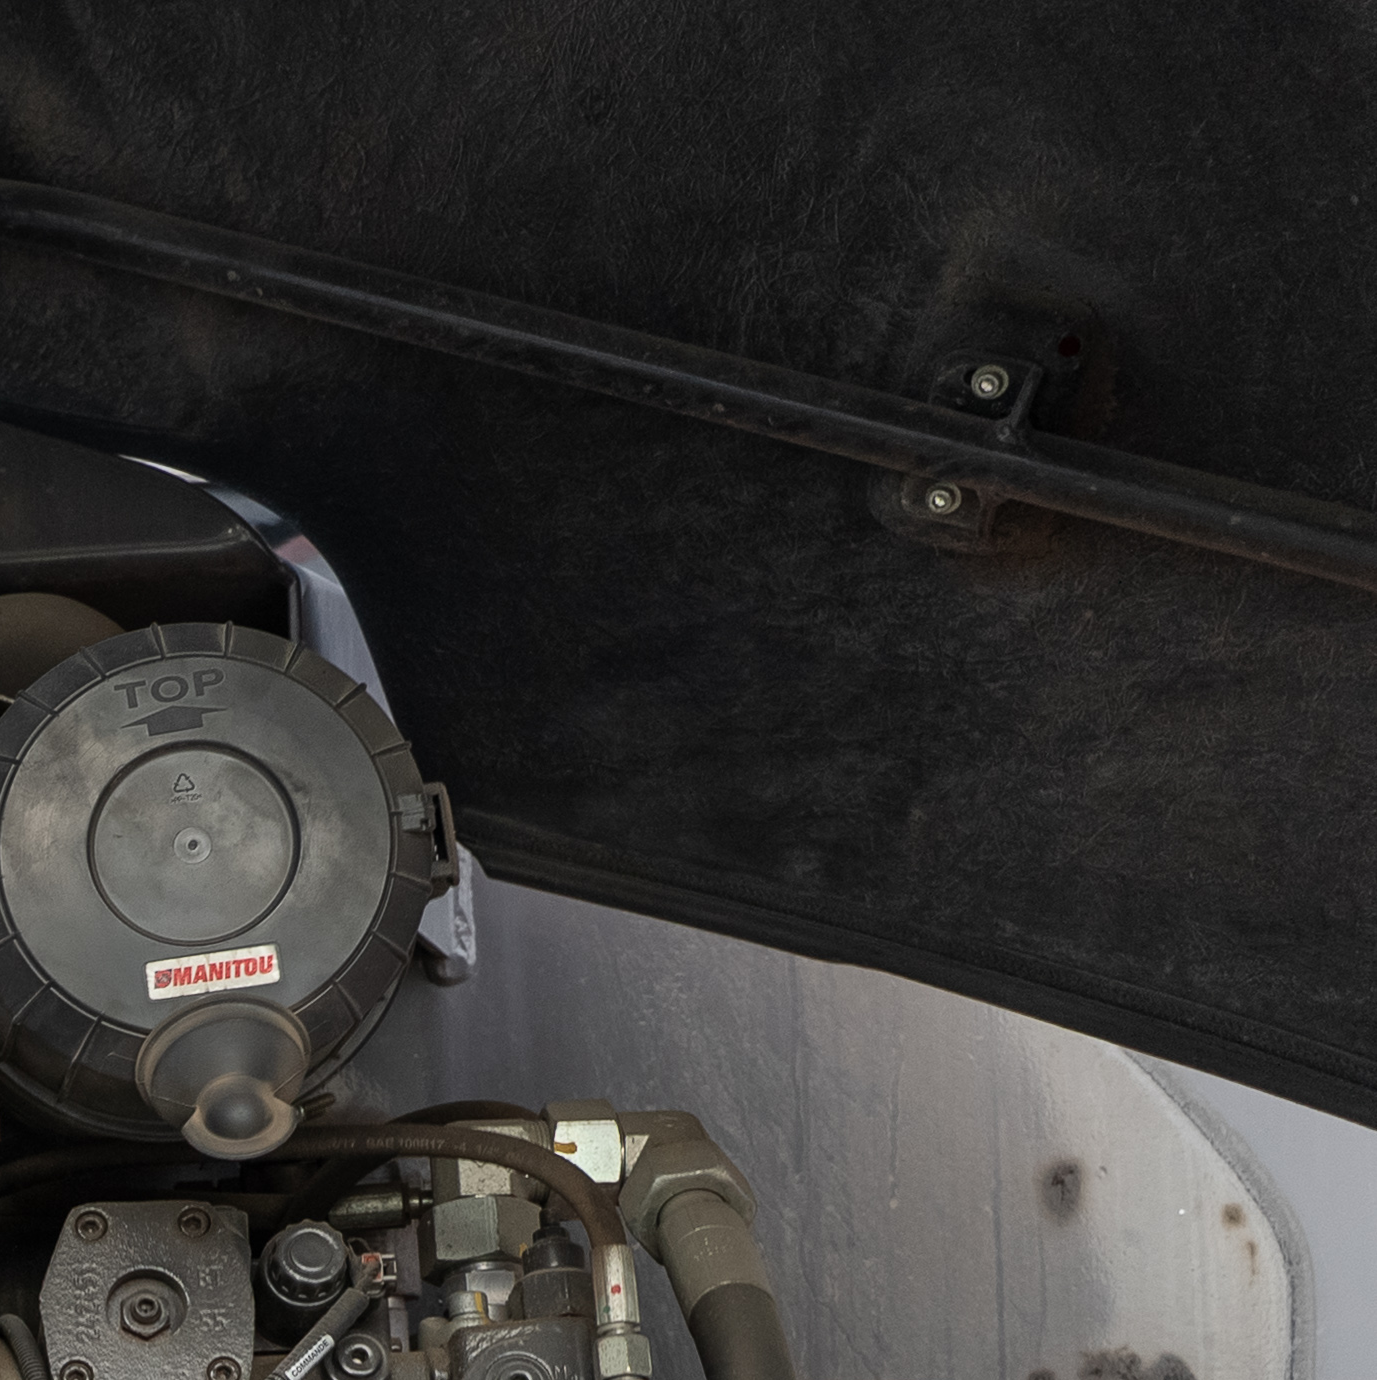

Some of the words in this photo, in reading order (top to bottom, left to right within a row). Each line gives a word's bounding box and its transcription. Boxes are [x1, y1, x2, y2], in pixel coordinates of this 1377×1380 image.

[114, 668, 226, 709] TOP
[173, 954, 274, 987] MANITOU
[291, 1339, 329, 1378] COMMANDE
